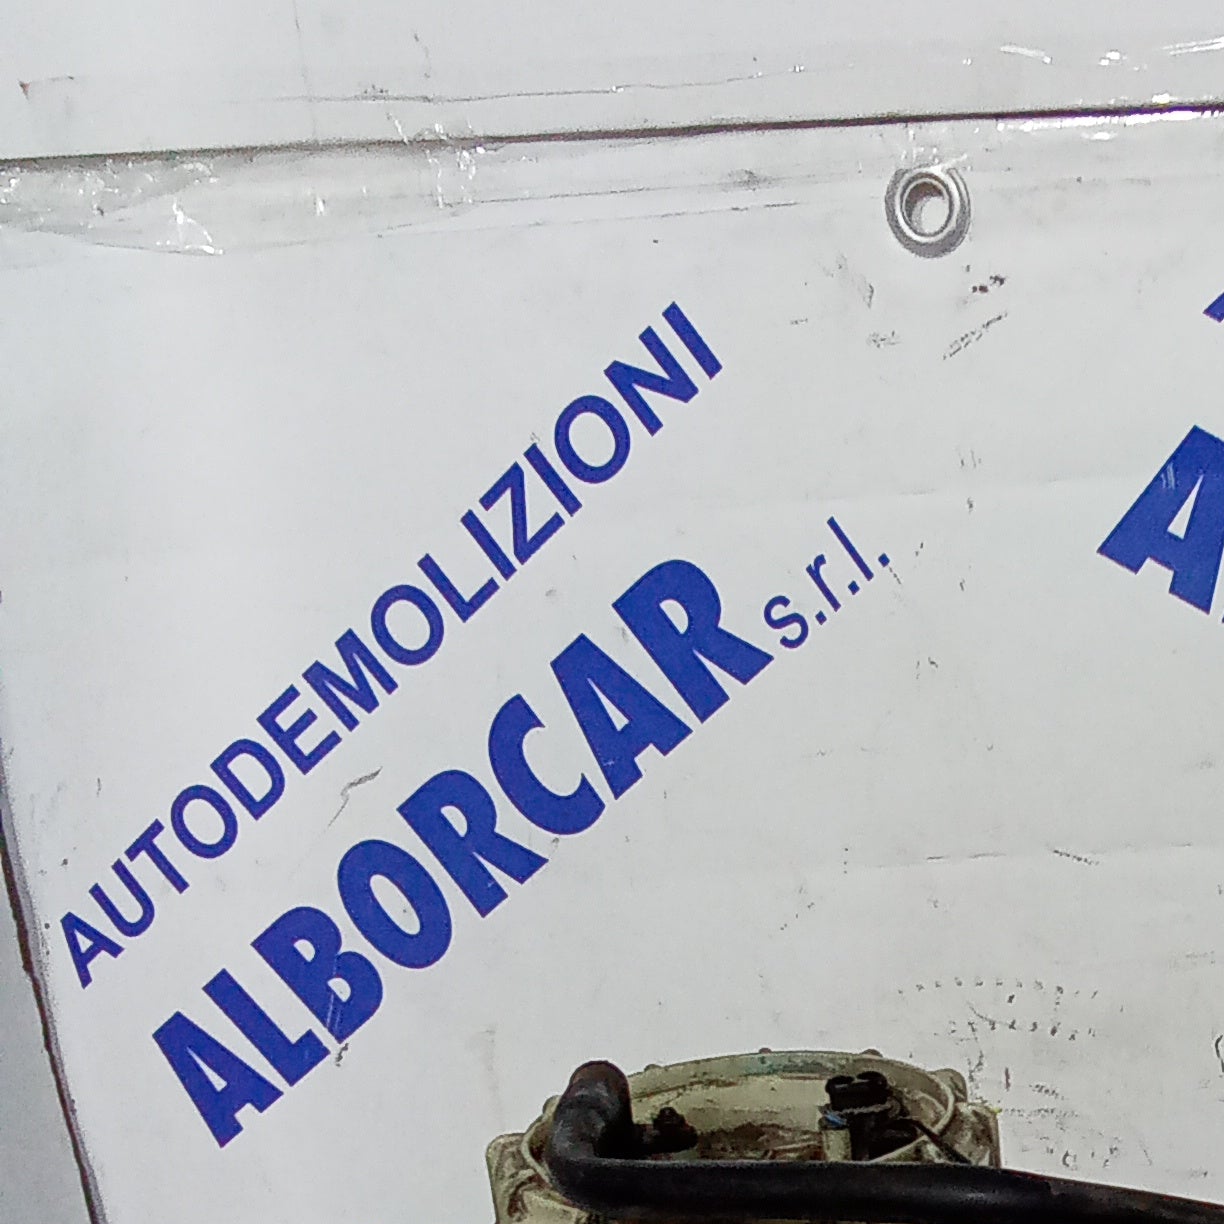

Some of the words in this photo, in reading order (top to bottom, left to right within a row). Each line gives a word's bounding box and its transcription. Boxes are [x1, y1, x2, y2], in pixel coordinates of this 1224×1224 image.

[61, 301, 723, 989] AUTODEMOLIZIONI
[151, 559, 775, 1148] ALBORCAR
[763, 516, 890, 650] s.r.l.
